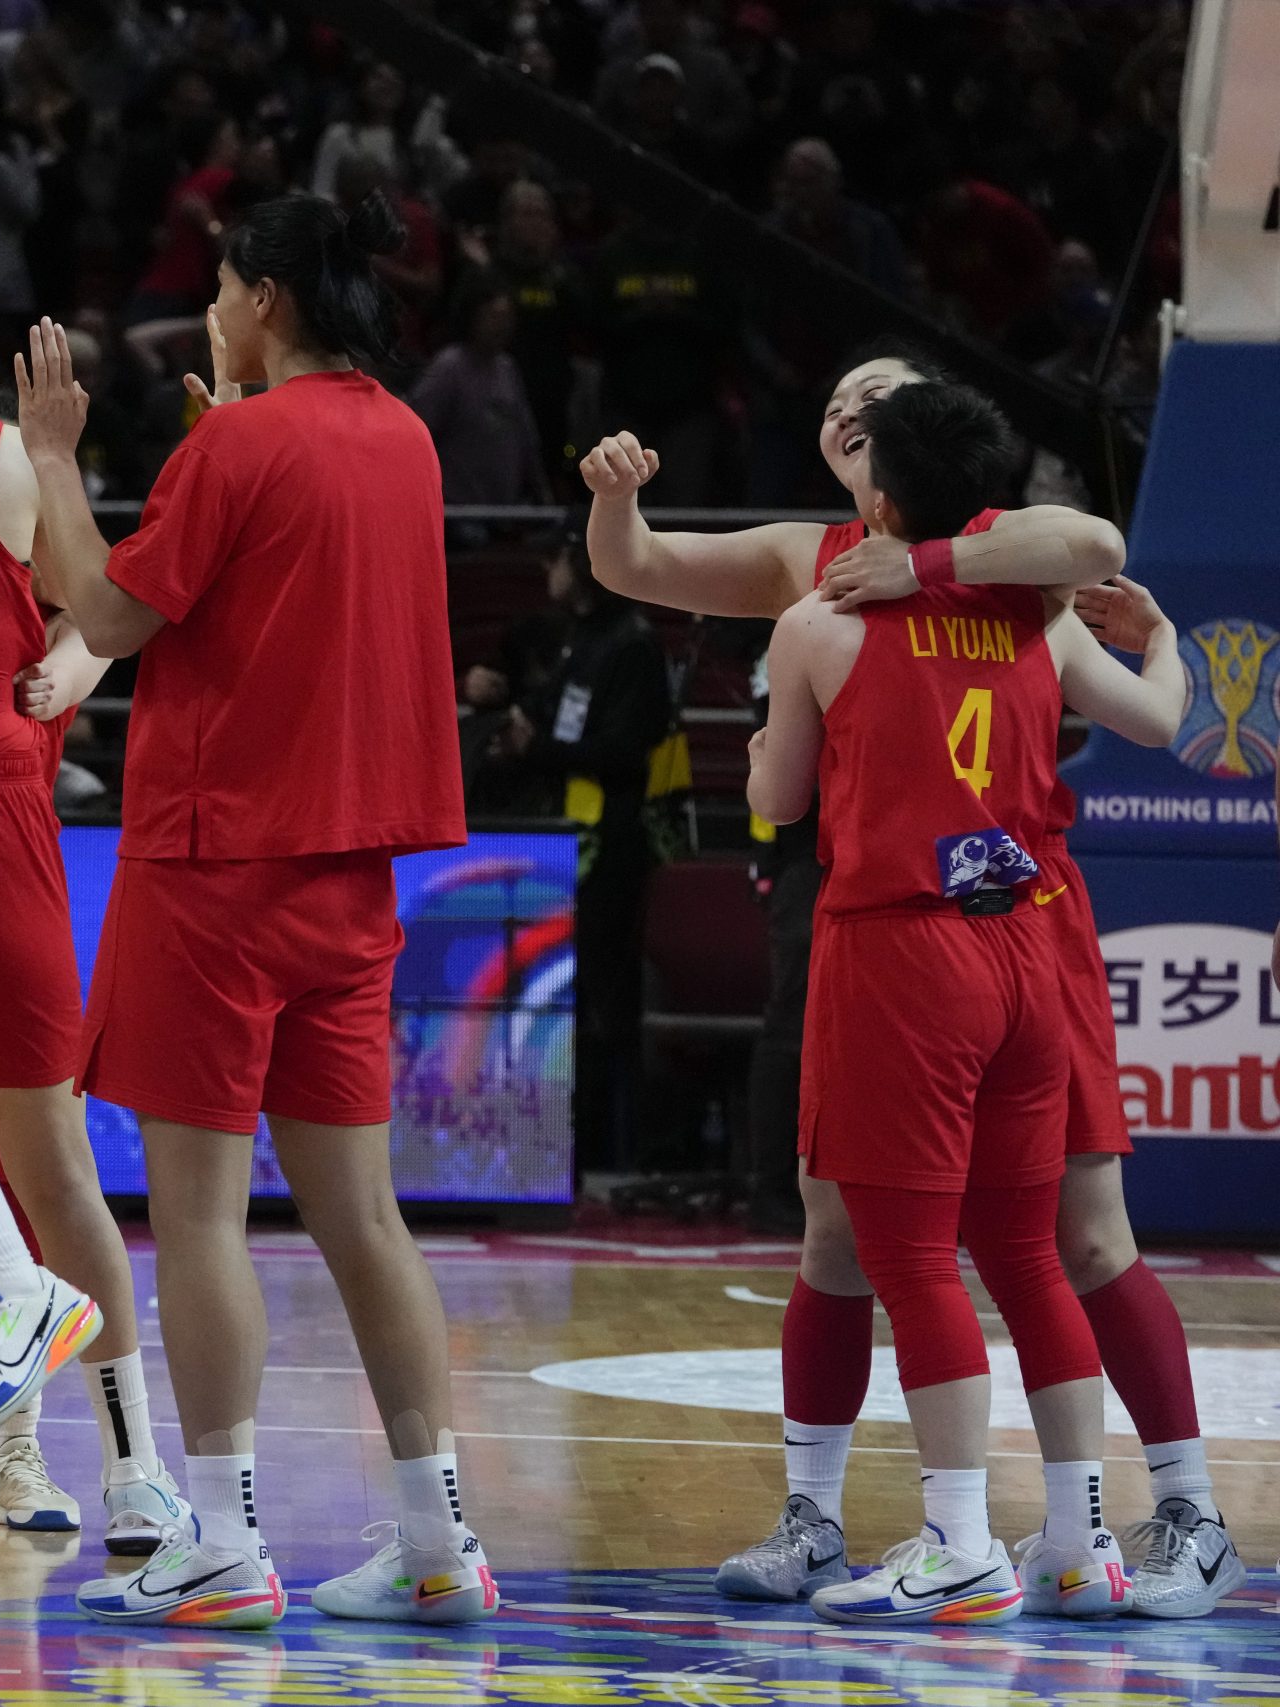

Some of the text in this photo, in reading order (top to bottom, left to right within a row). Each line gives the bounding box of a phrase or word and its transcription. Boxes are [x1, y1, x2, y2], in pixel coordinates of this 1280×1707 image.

[941, 617, 1016, 663] YUAN
[947, 687, 993, 800] 4
[1084, 795, 1211, 822] NOTHING
